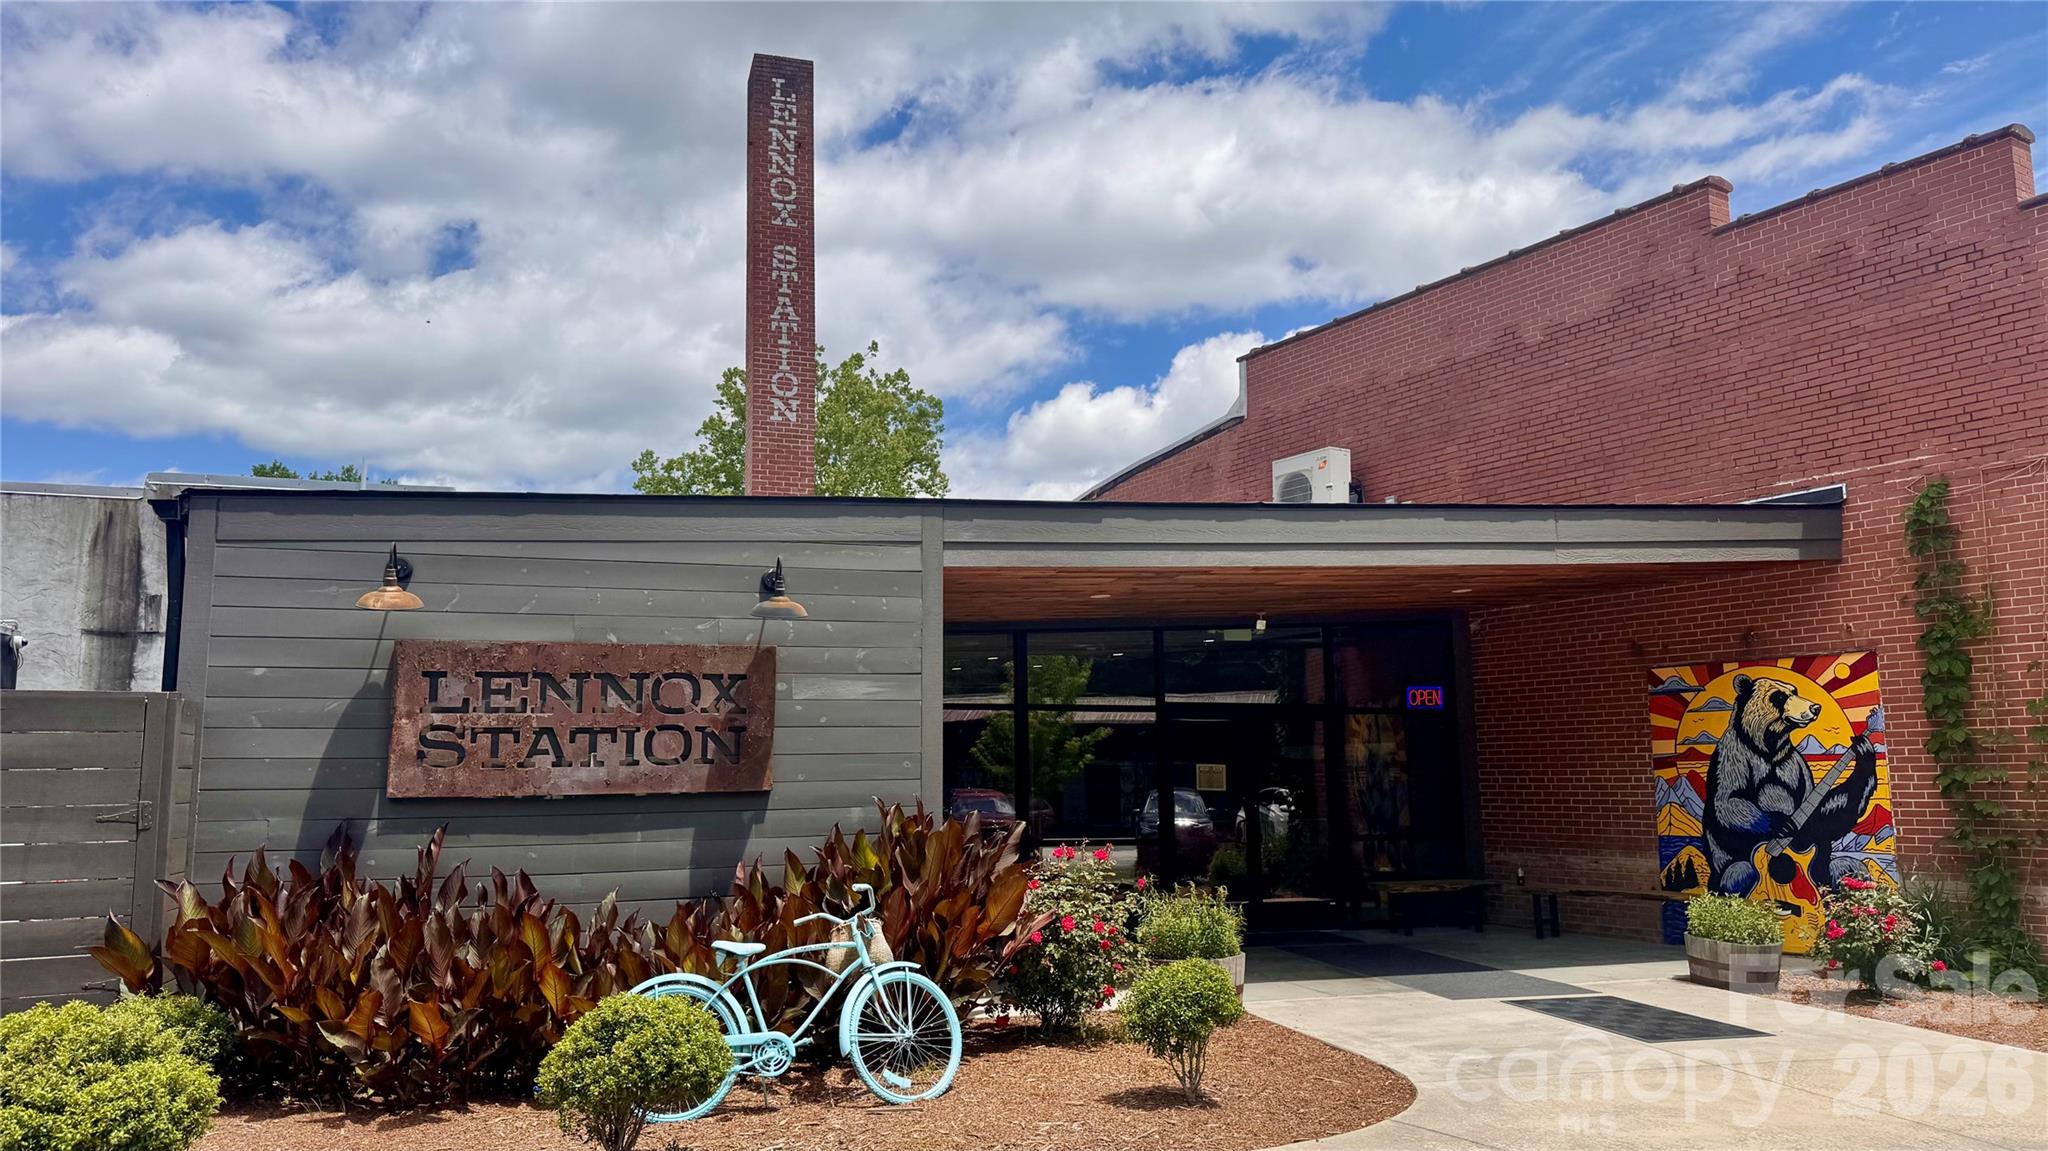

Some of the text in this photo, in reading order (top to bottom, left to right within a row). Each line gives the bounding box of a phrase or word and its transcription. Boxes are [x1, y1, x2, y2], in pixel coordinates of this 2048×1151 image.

[768, 77, 799, 422] LENNOX STATION
[419, 670, 748, 715] LENNOX
[1409, 689, 1441, 706] OPEN
[416, 723, 747, 770] STATION
